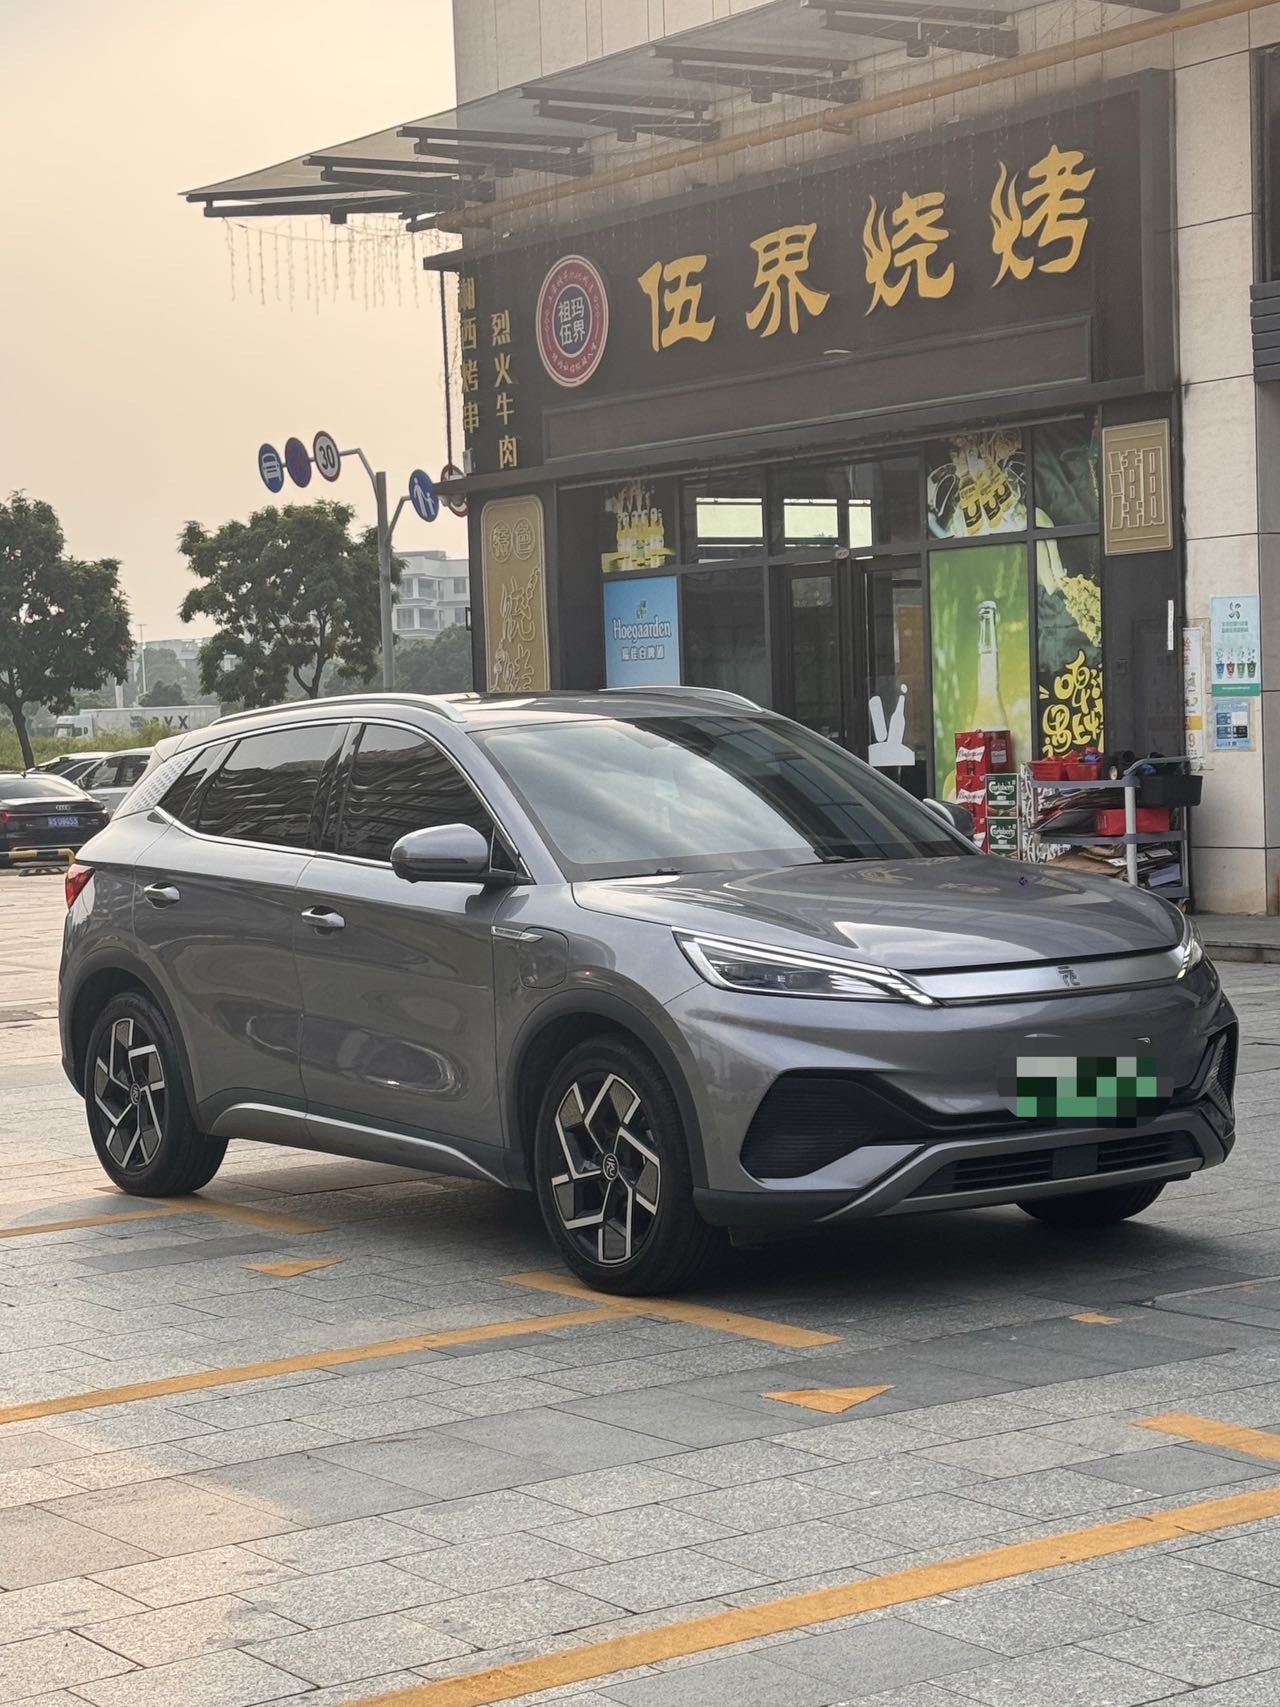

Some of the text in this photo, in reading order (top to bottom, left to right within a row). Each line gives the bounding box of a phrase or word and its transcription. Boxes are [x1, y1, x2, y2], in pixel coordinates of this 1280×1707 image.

[638, 144, 1096, 352] 伍界烧烤
[558, 297, 585, 323] 祖玛
[559, 320, 586, 346] 伍界
[491, 309, 518, 469] 烈火牛肉
[318, 445, 336, 471] 30
[1108, 447, 1165, 530] 潮
[612, 615, 672, 643] Hoegaarden
[988, 780, 1015, 796] Carlsberg
[989, 823, 1016, 840] Carlsberg
